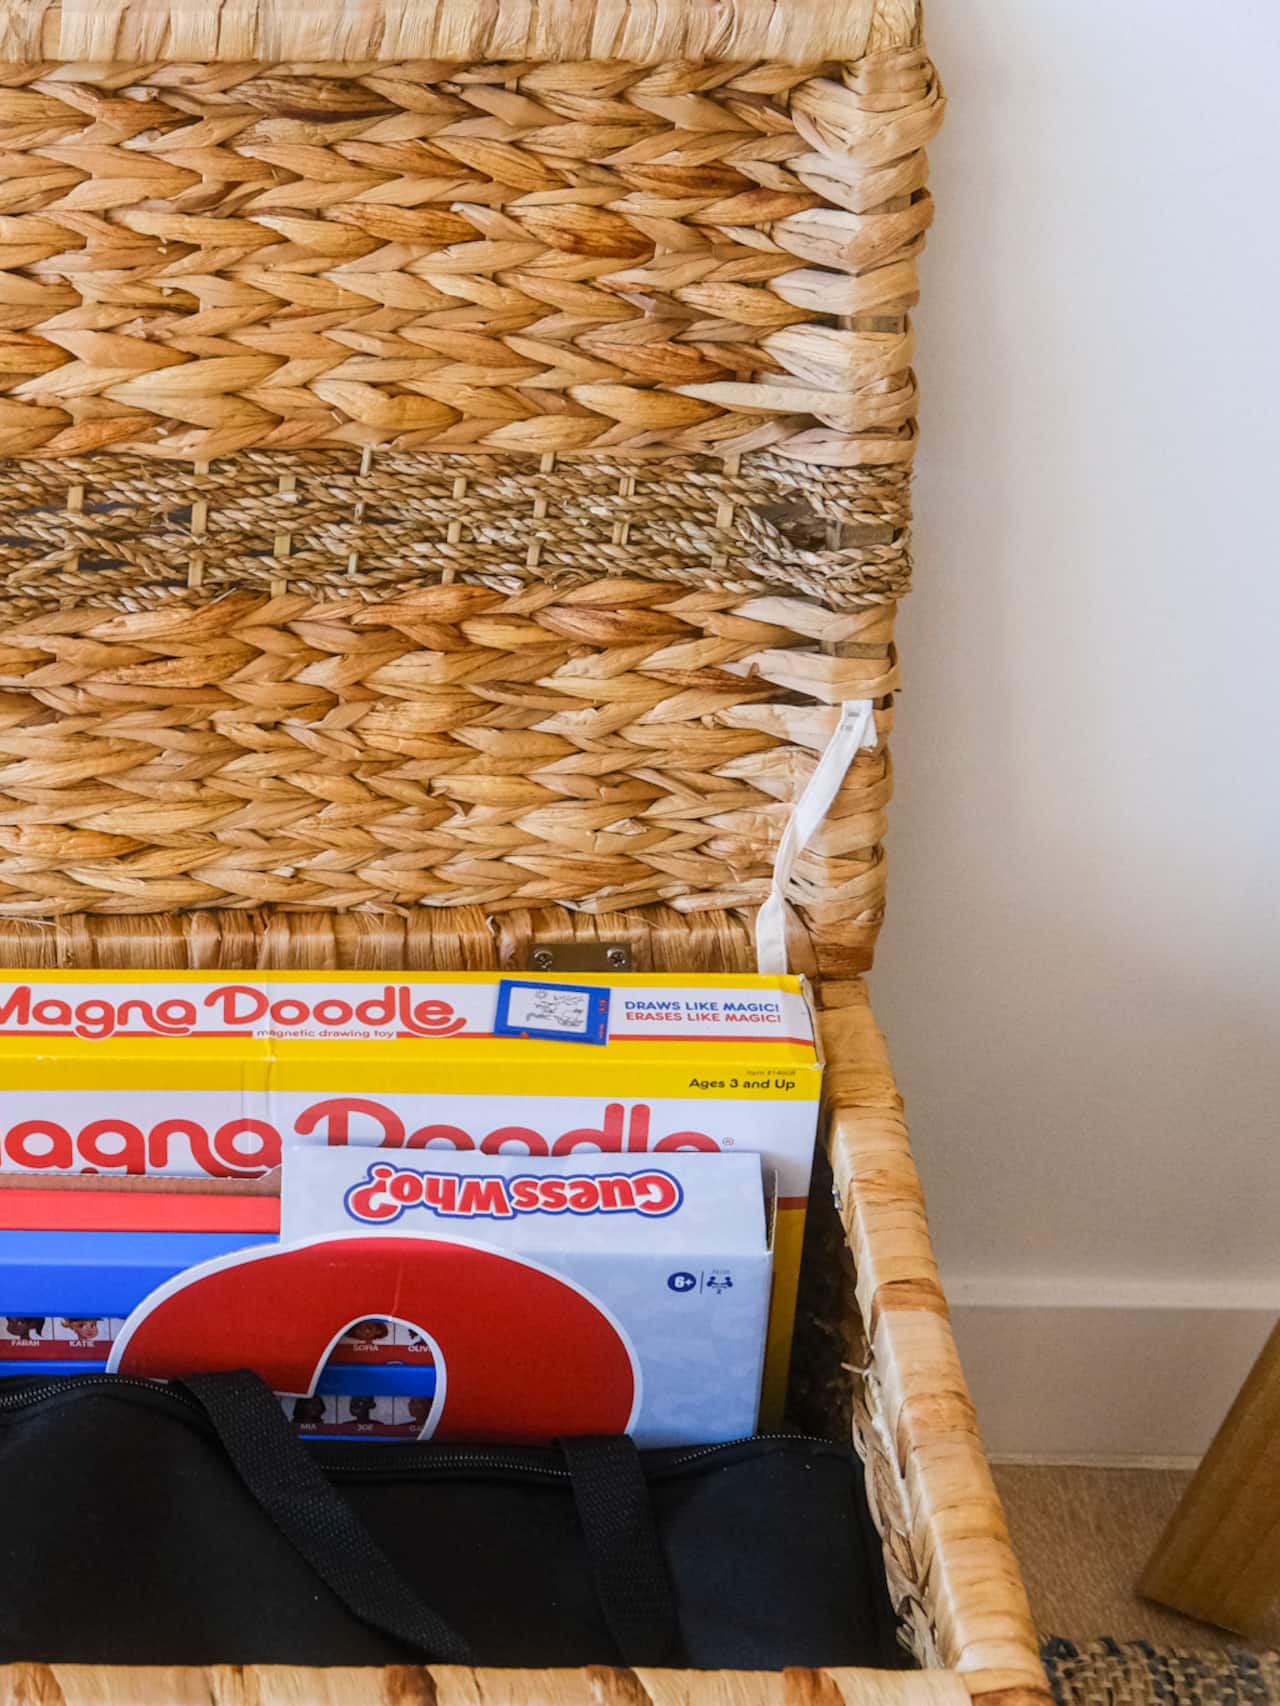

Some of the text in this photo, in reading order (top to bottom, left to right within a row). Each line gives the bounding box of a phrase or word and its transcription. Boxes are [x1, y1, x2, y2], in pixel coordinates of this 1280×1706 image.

[204, 985, 468, 1039] Doodle
[624, 1000, 781, 1013] DRAWS LIKE MAGIC!
[625, 1011, 782, 1024] ERASES LIKE MAGIC!
[256, 1028, 394, 1039] magnetic drawing toy
[688, 1078, 796, 1091] Ages 3 and Up
[350, 1167, 677, 1220] Guess Who?
